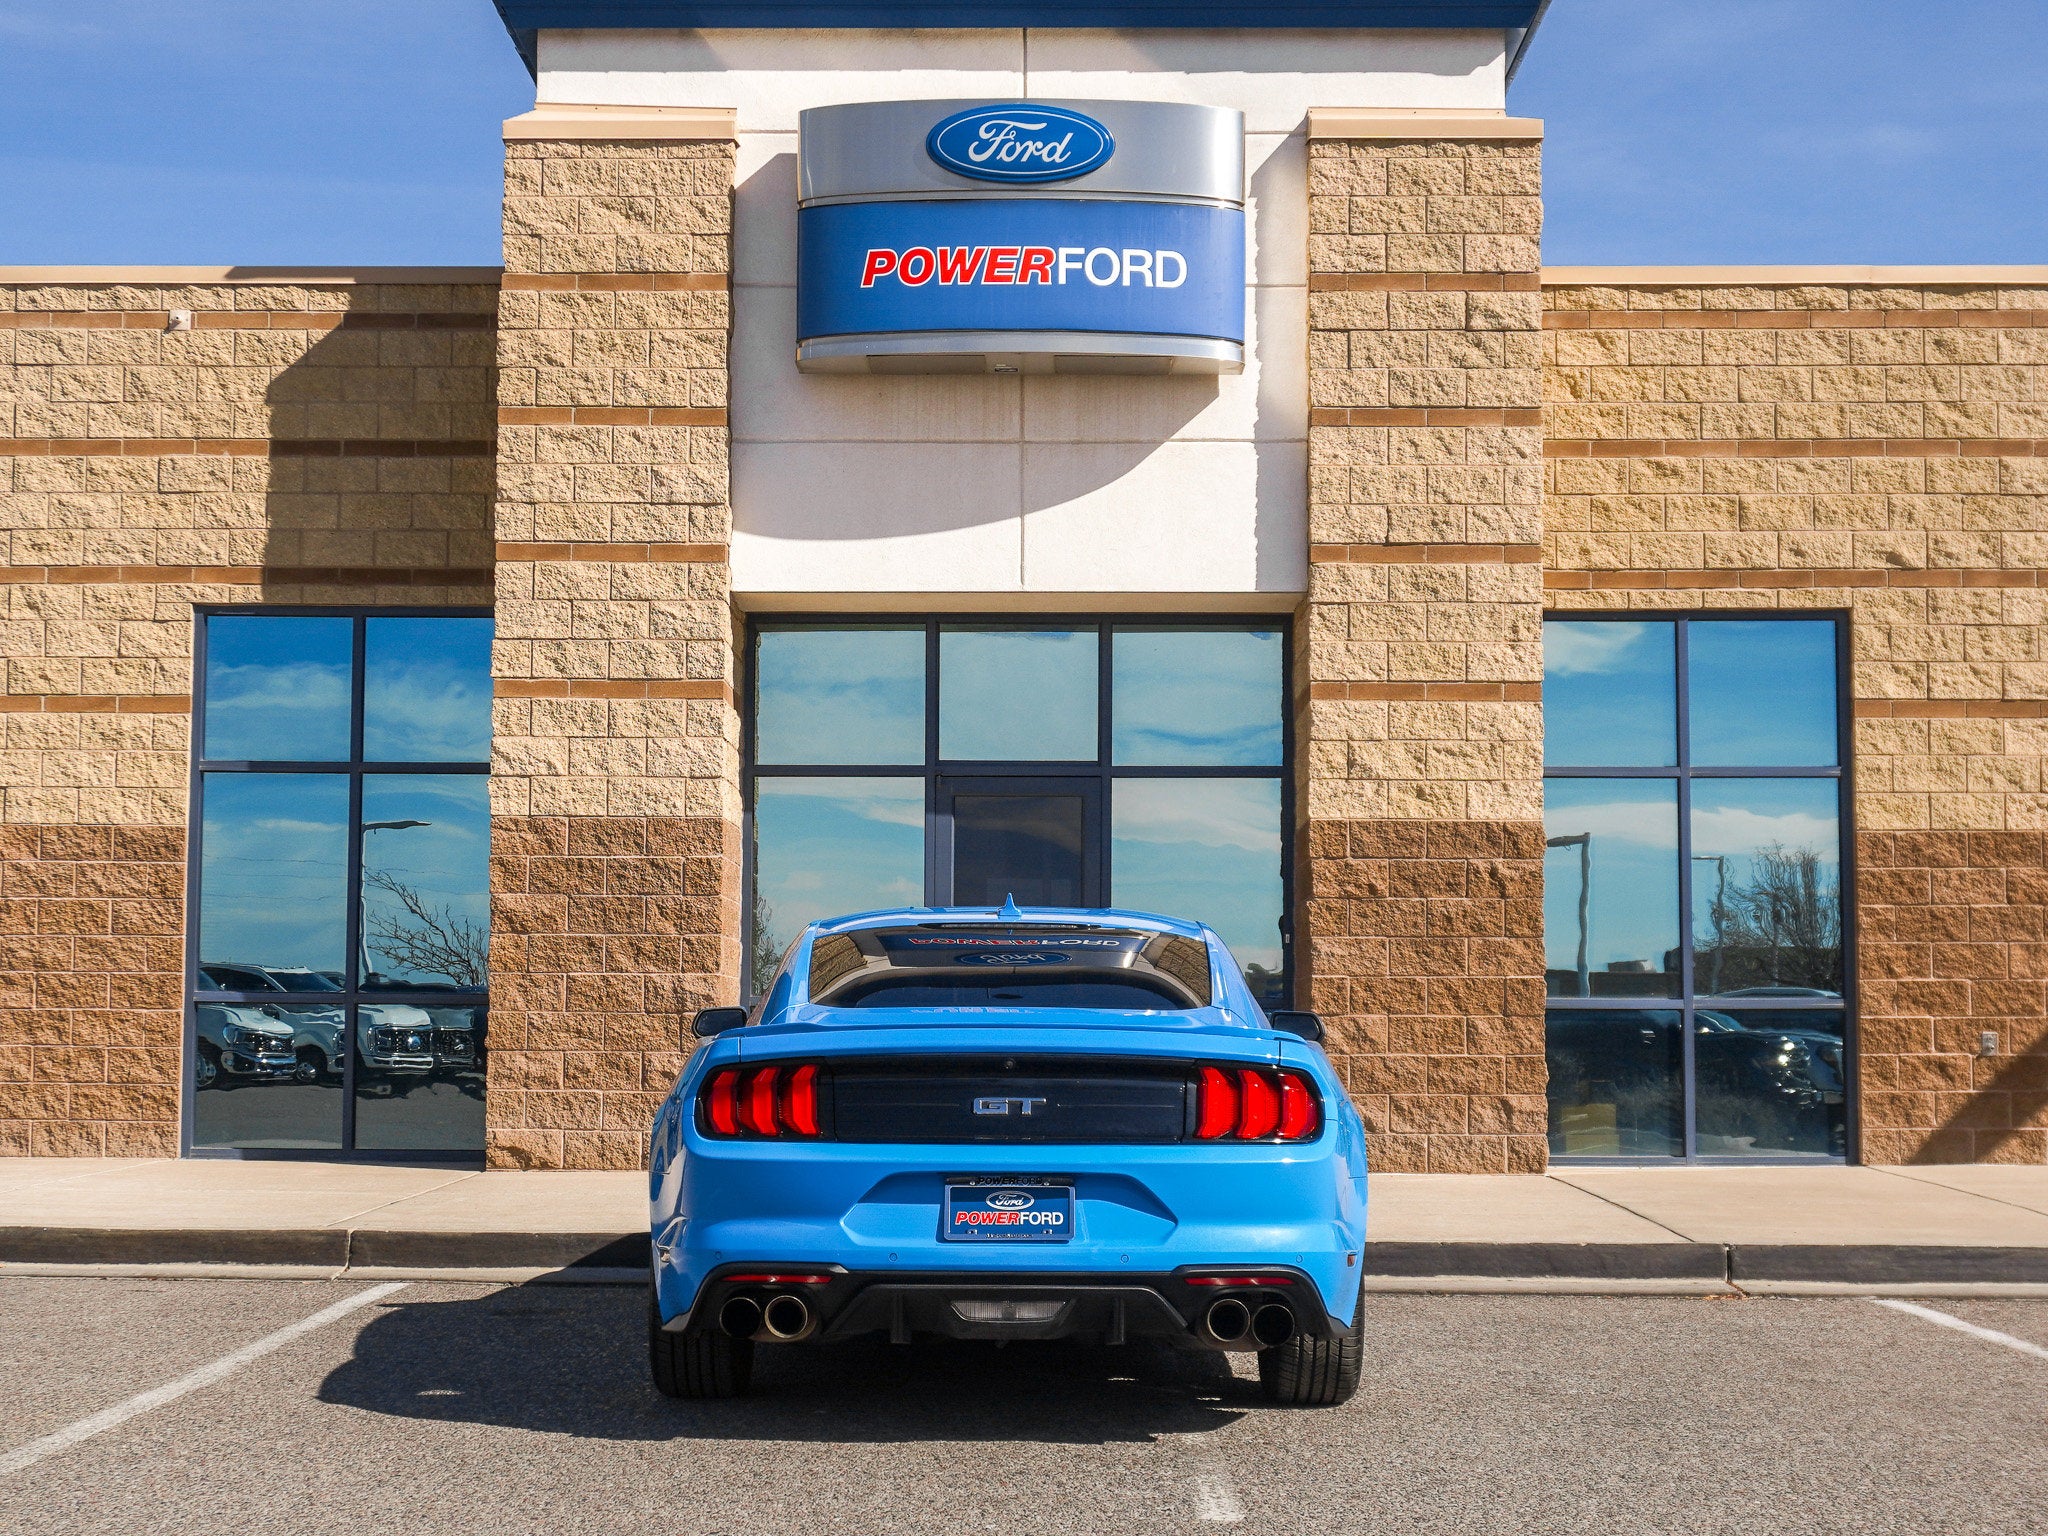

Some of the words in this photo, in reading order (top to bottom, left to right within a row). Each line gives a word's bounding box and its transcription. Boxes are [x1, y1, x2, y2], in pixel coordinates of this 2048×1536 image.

[968, 119, 1073, 164] Ford
[860, 245, 1188, 289] POWERFORD
[973, 1097, 1047, 1115] GT
[995, 1193, 1024, 1207] Ford
[955, 1211, 1063, 1225] POWERFORD
